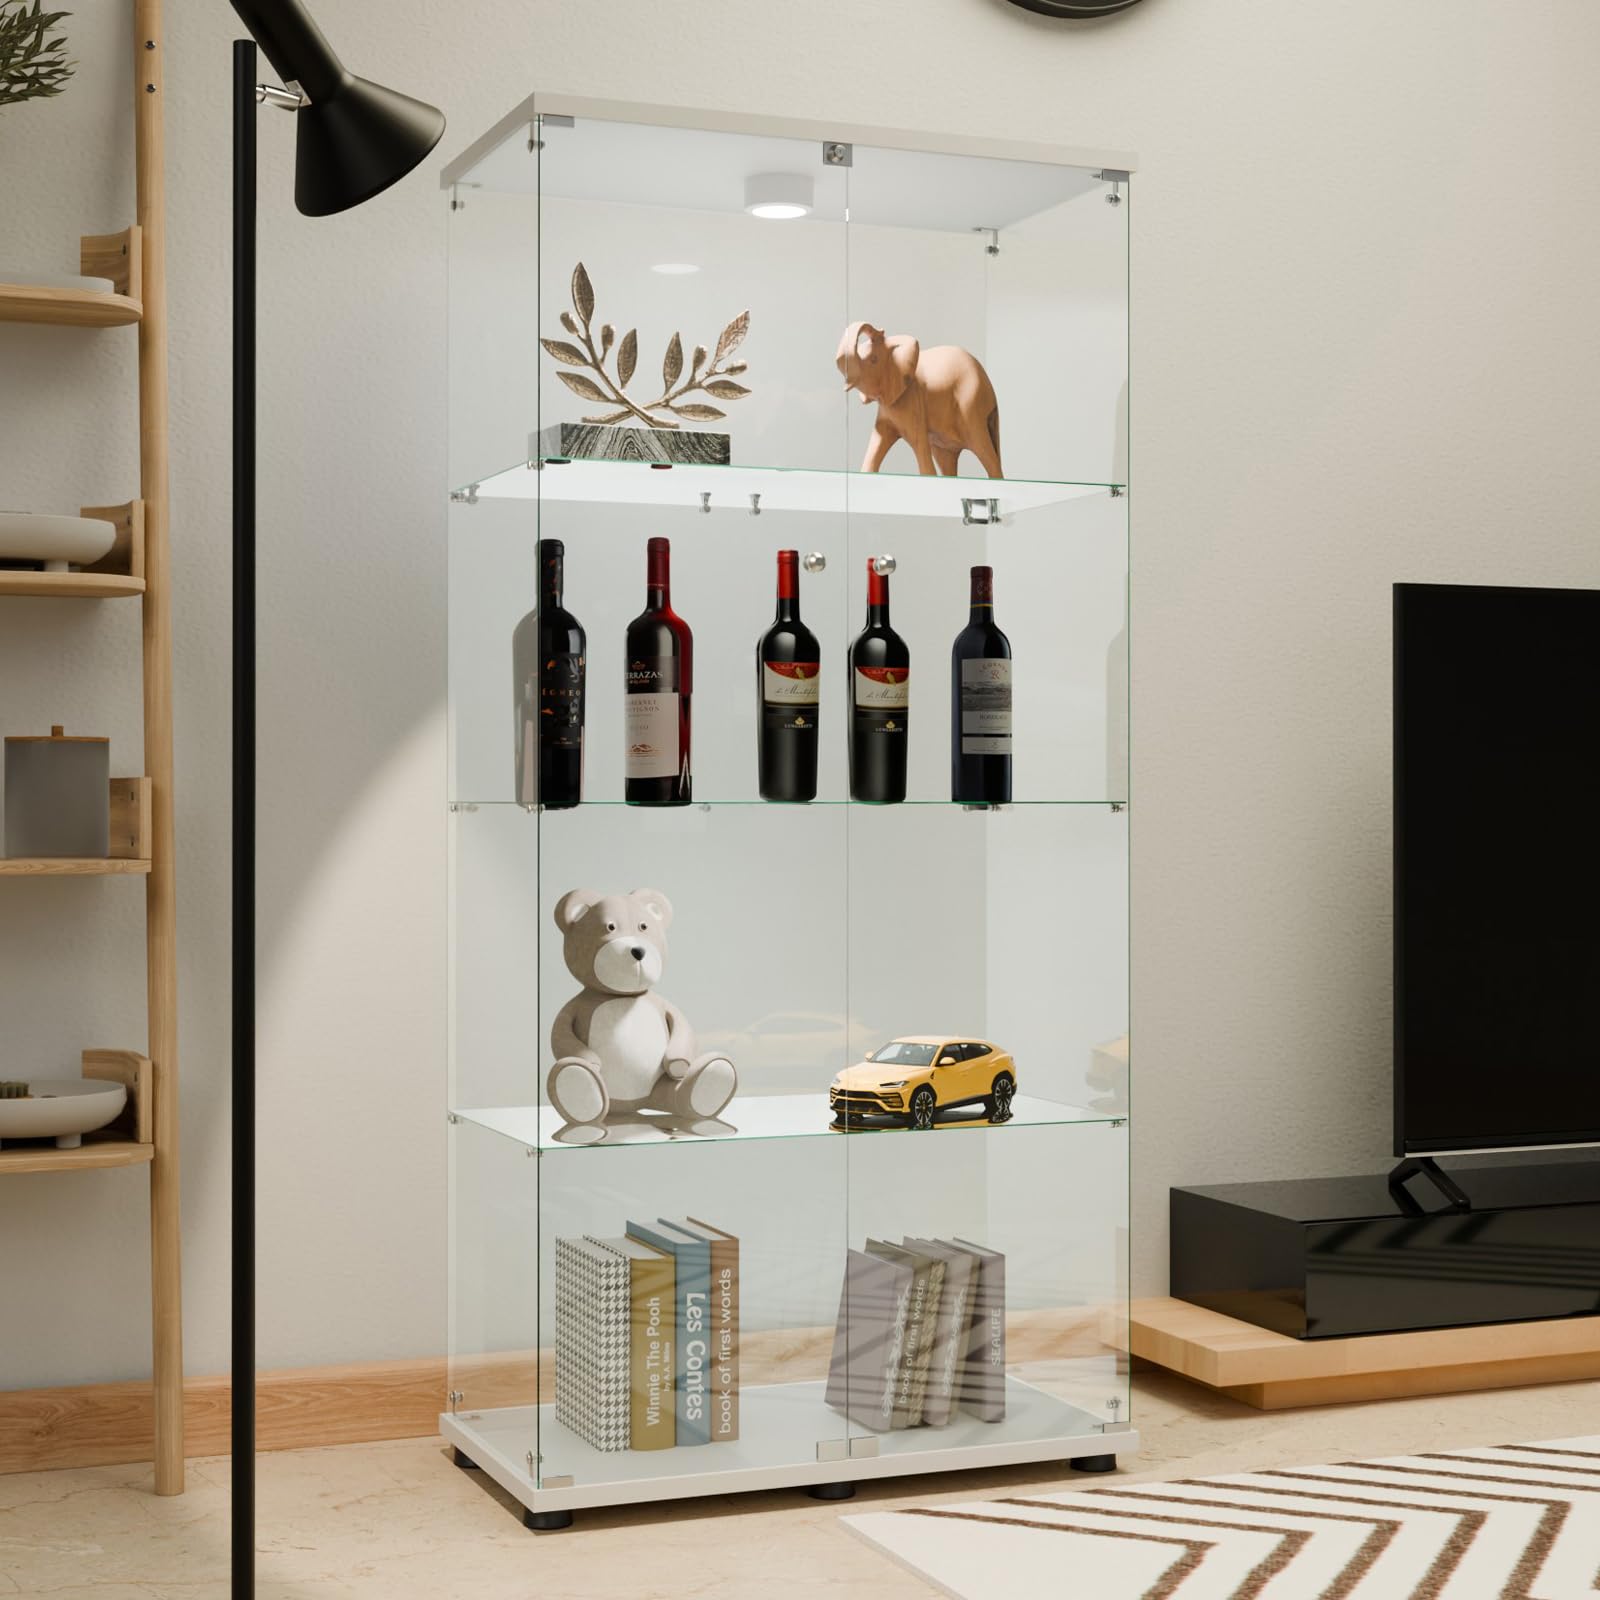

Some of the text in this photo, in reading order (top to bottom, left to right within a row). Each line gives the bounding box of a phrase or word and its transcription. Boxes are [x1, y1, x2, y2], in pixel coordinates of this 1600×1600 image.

[646, 1296, 661, 1427] Winnie The Pooh
[686, 1292, 706, 1421] Les Contes
[718, 1268, 732, 1434] book of first words
[899, 1372, 913, 1405] book
[906, 1350, 914, 1367] of
[913, 1278, 927, 1321] words
[991, 1307, 1002, 1368] SEALIFE
